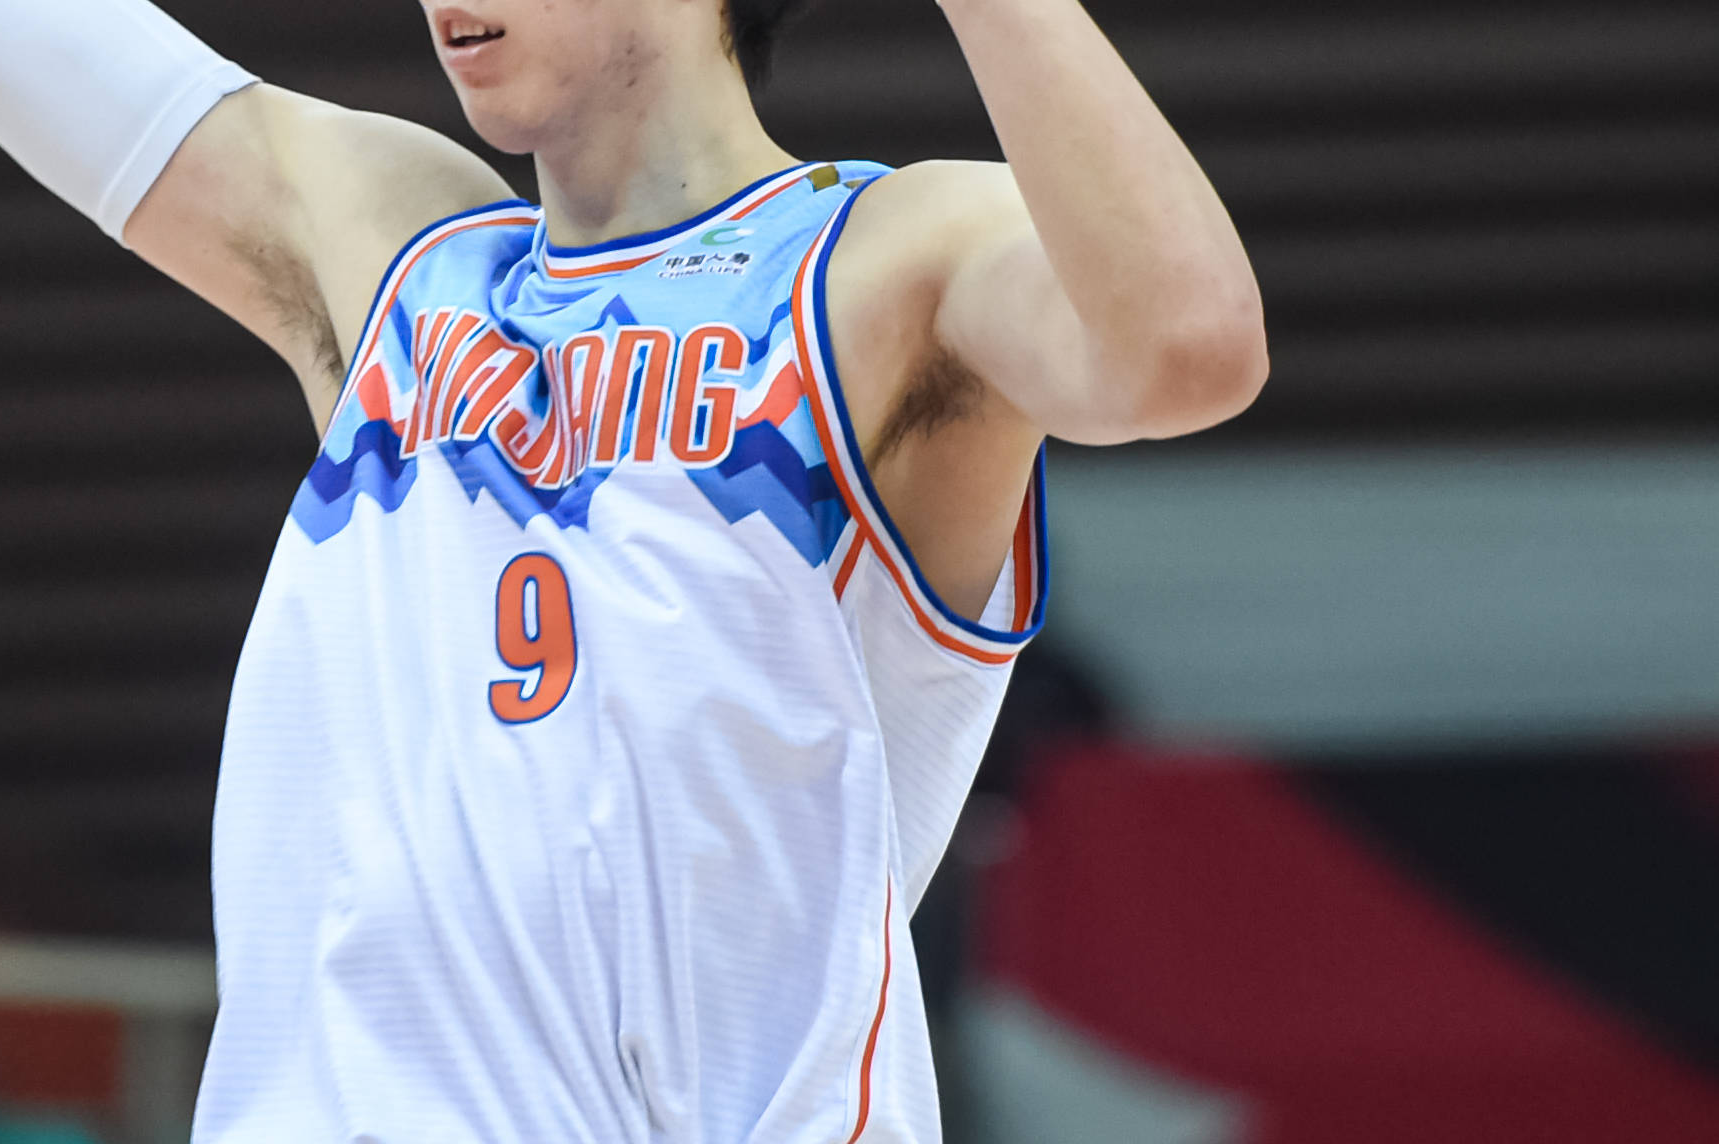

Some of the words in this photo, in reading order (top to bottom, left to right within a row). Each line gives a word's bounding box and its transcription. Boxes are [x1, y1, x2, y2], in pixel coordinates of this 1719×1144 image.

[665, 252, 751, 269] 中国人寿
[658, 268, 703, 278] CHINA
[709, 265, 744, 275] LIFE
[489, 552, 579, 724] 9
